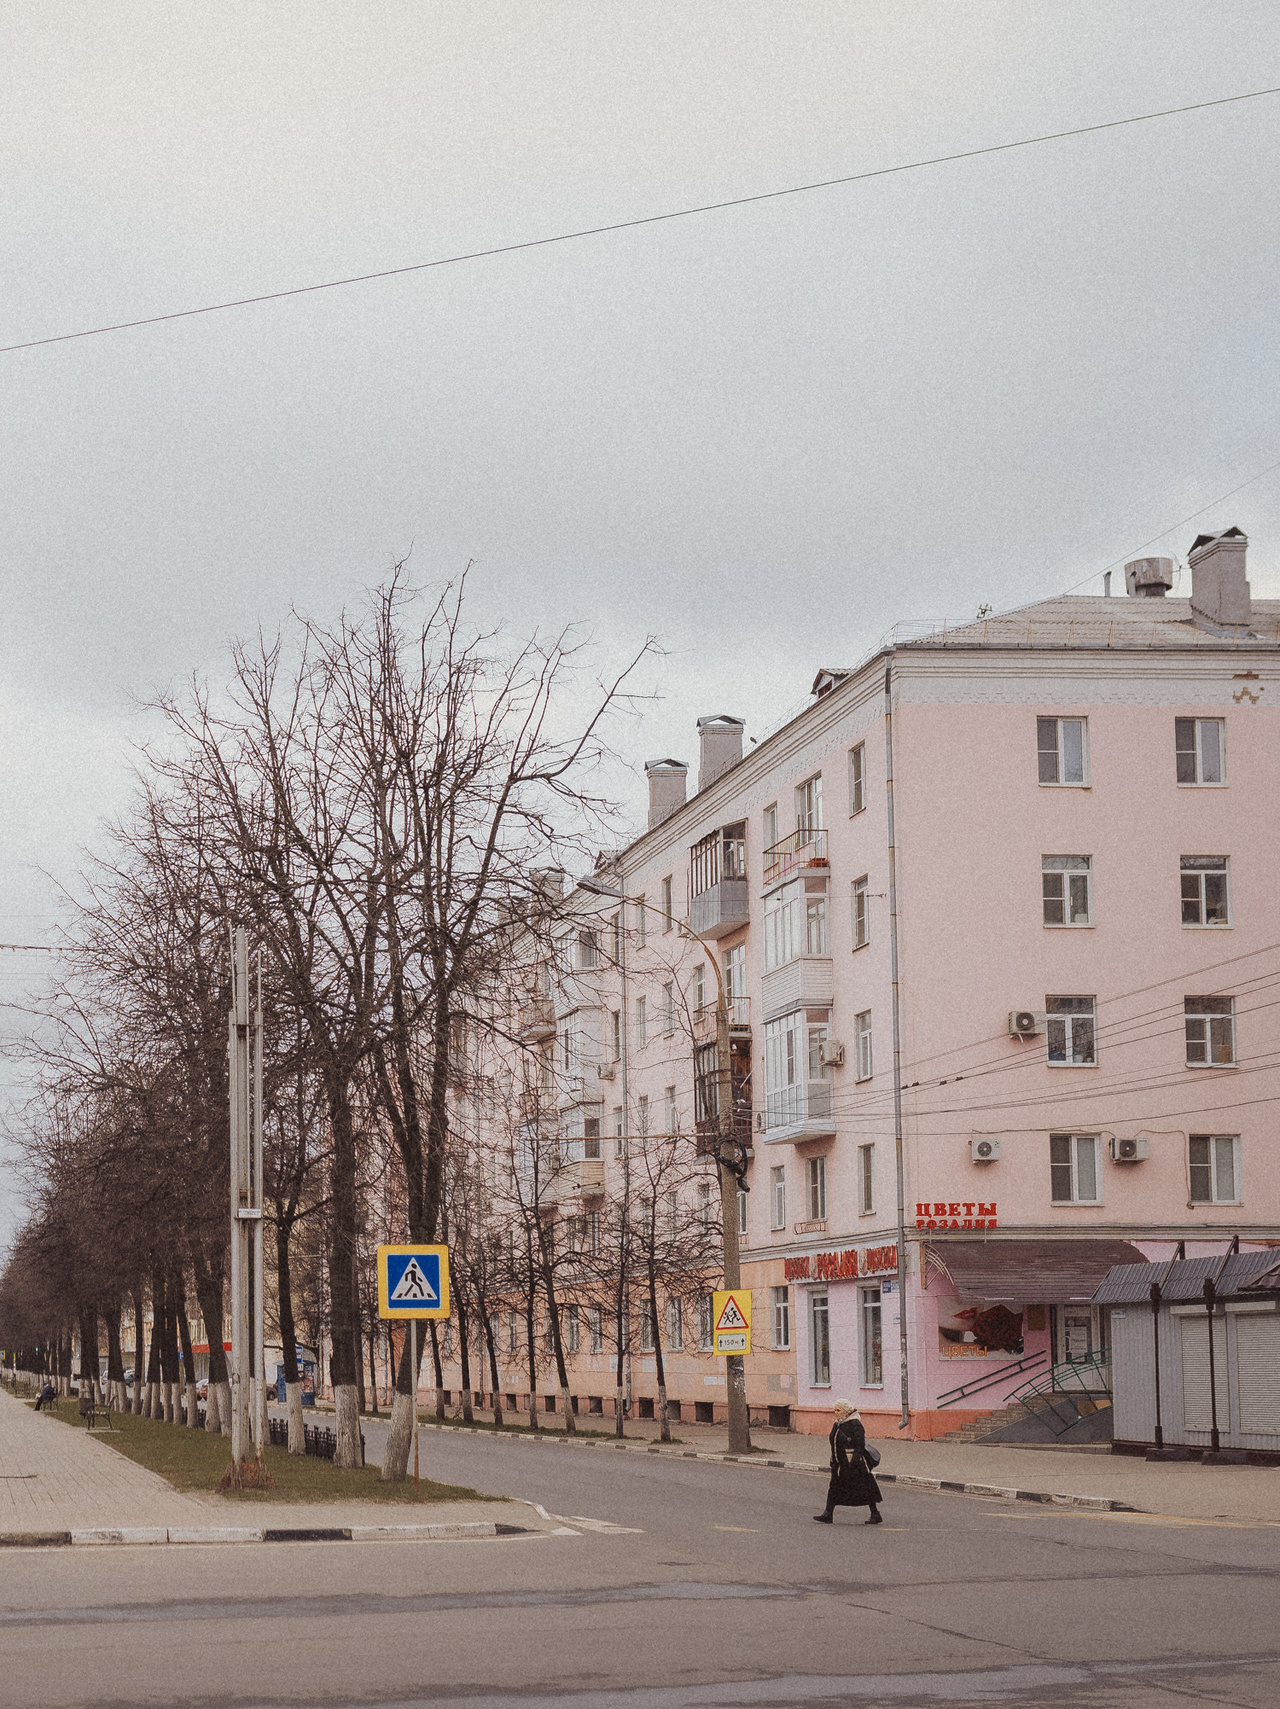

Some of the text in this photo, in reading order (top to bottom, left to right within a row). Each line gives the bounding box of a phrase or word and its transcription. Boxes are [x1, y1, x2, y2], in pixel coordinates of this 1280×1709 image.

[915, 1203, 997, 1218] ЦВЕТЫ
[916, 1219, 998, 1229] РОЗАЛИЯ
[942, 1345, 987, 1359] ЦВЕТЫ
